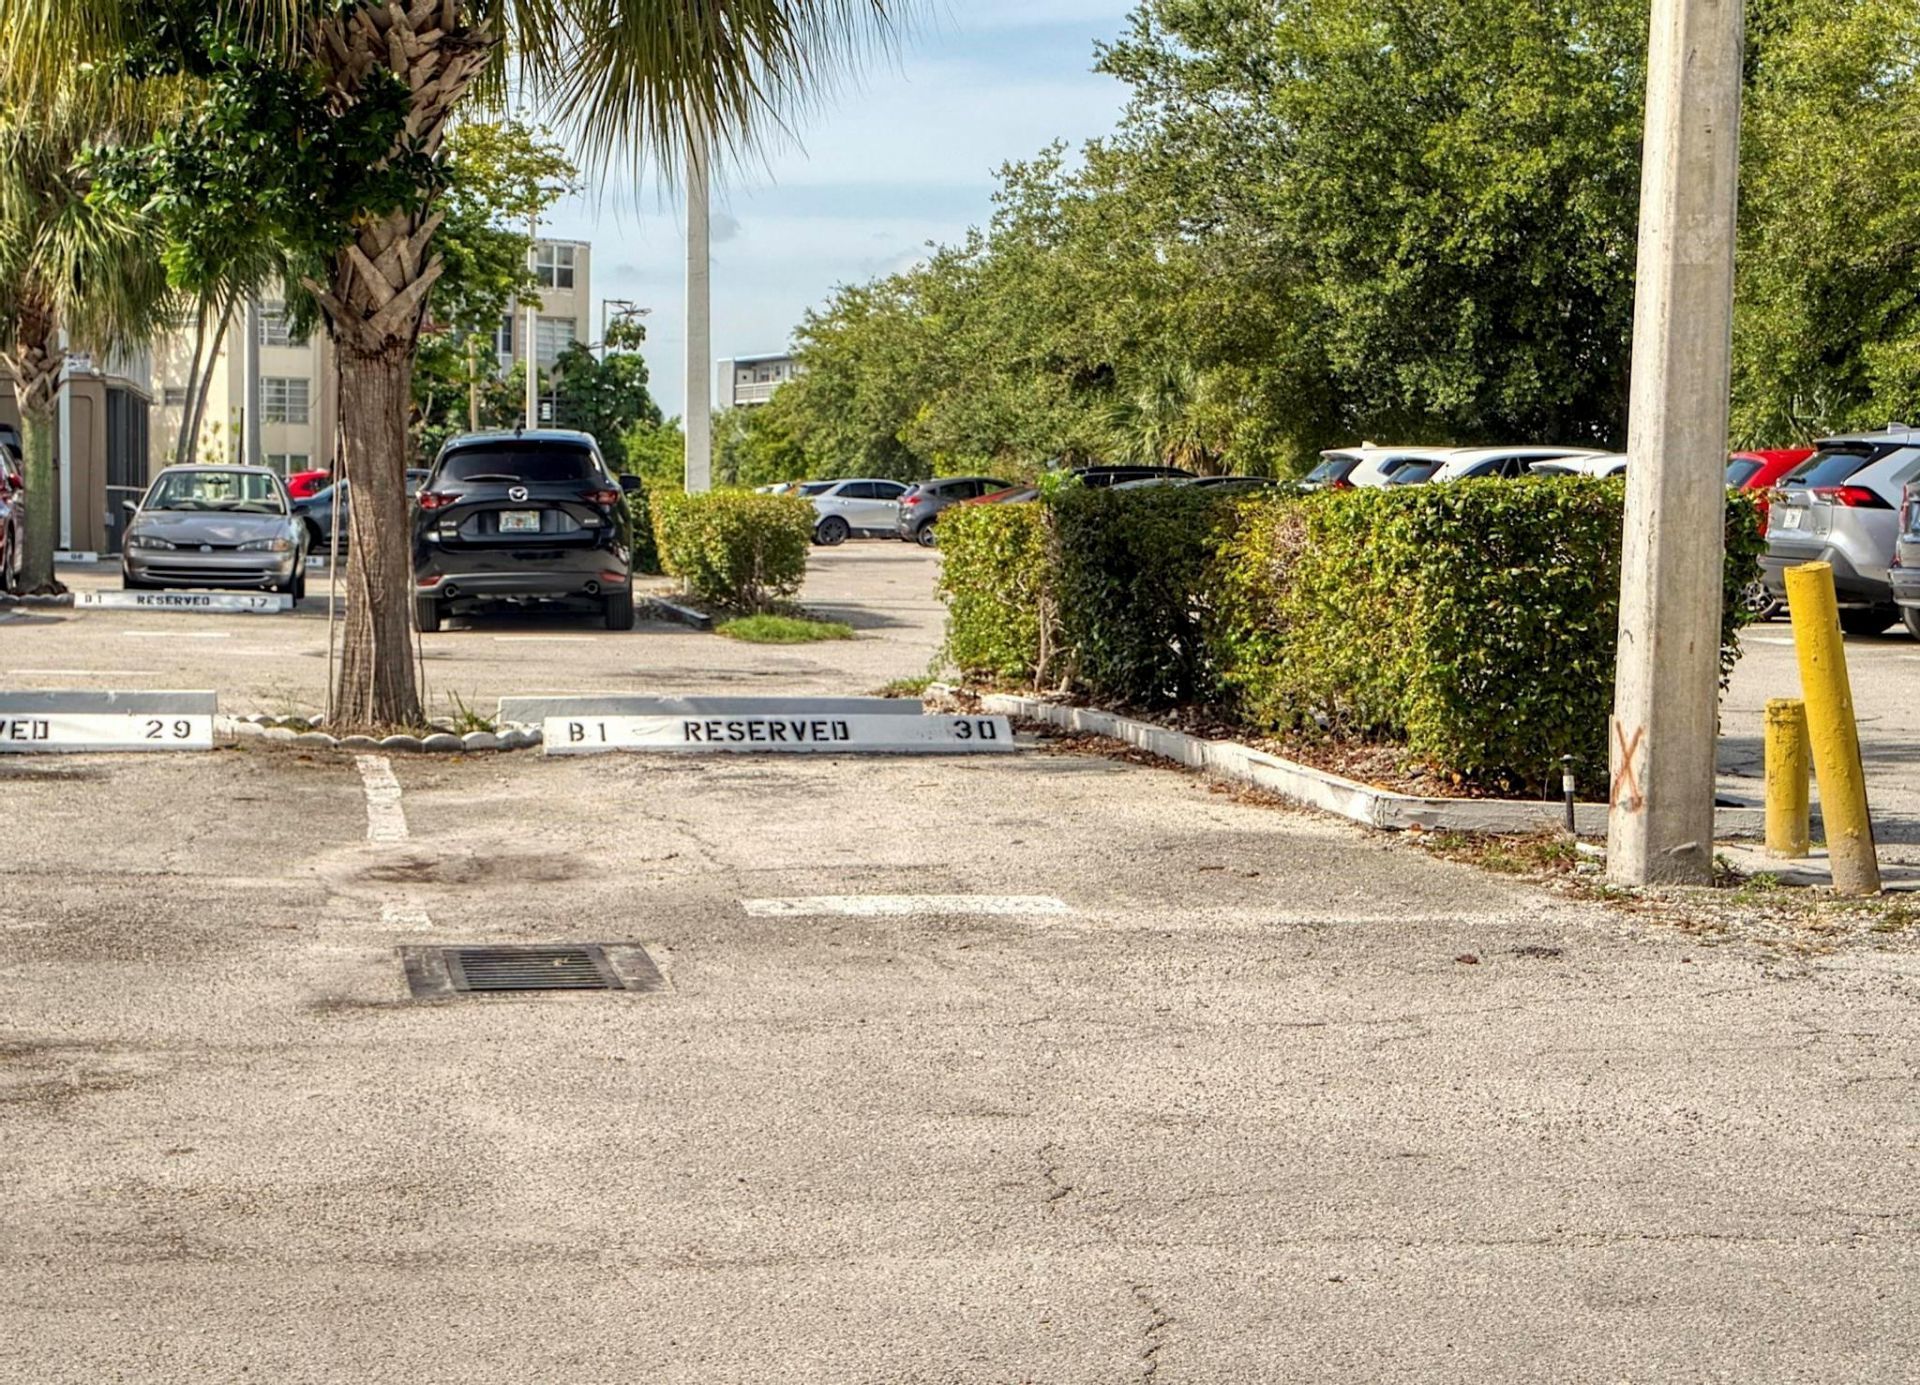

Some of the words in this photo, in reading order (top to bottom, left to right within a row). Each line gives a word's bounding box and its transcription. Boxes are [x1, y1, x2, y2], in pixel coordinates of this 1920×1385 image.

[136, 595, 211, 606] RESERVED
[145, 720, 191, 739] 29
[684, 720, 850, 742] RESERVED
[953, 719, 997, 740] 30
